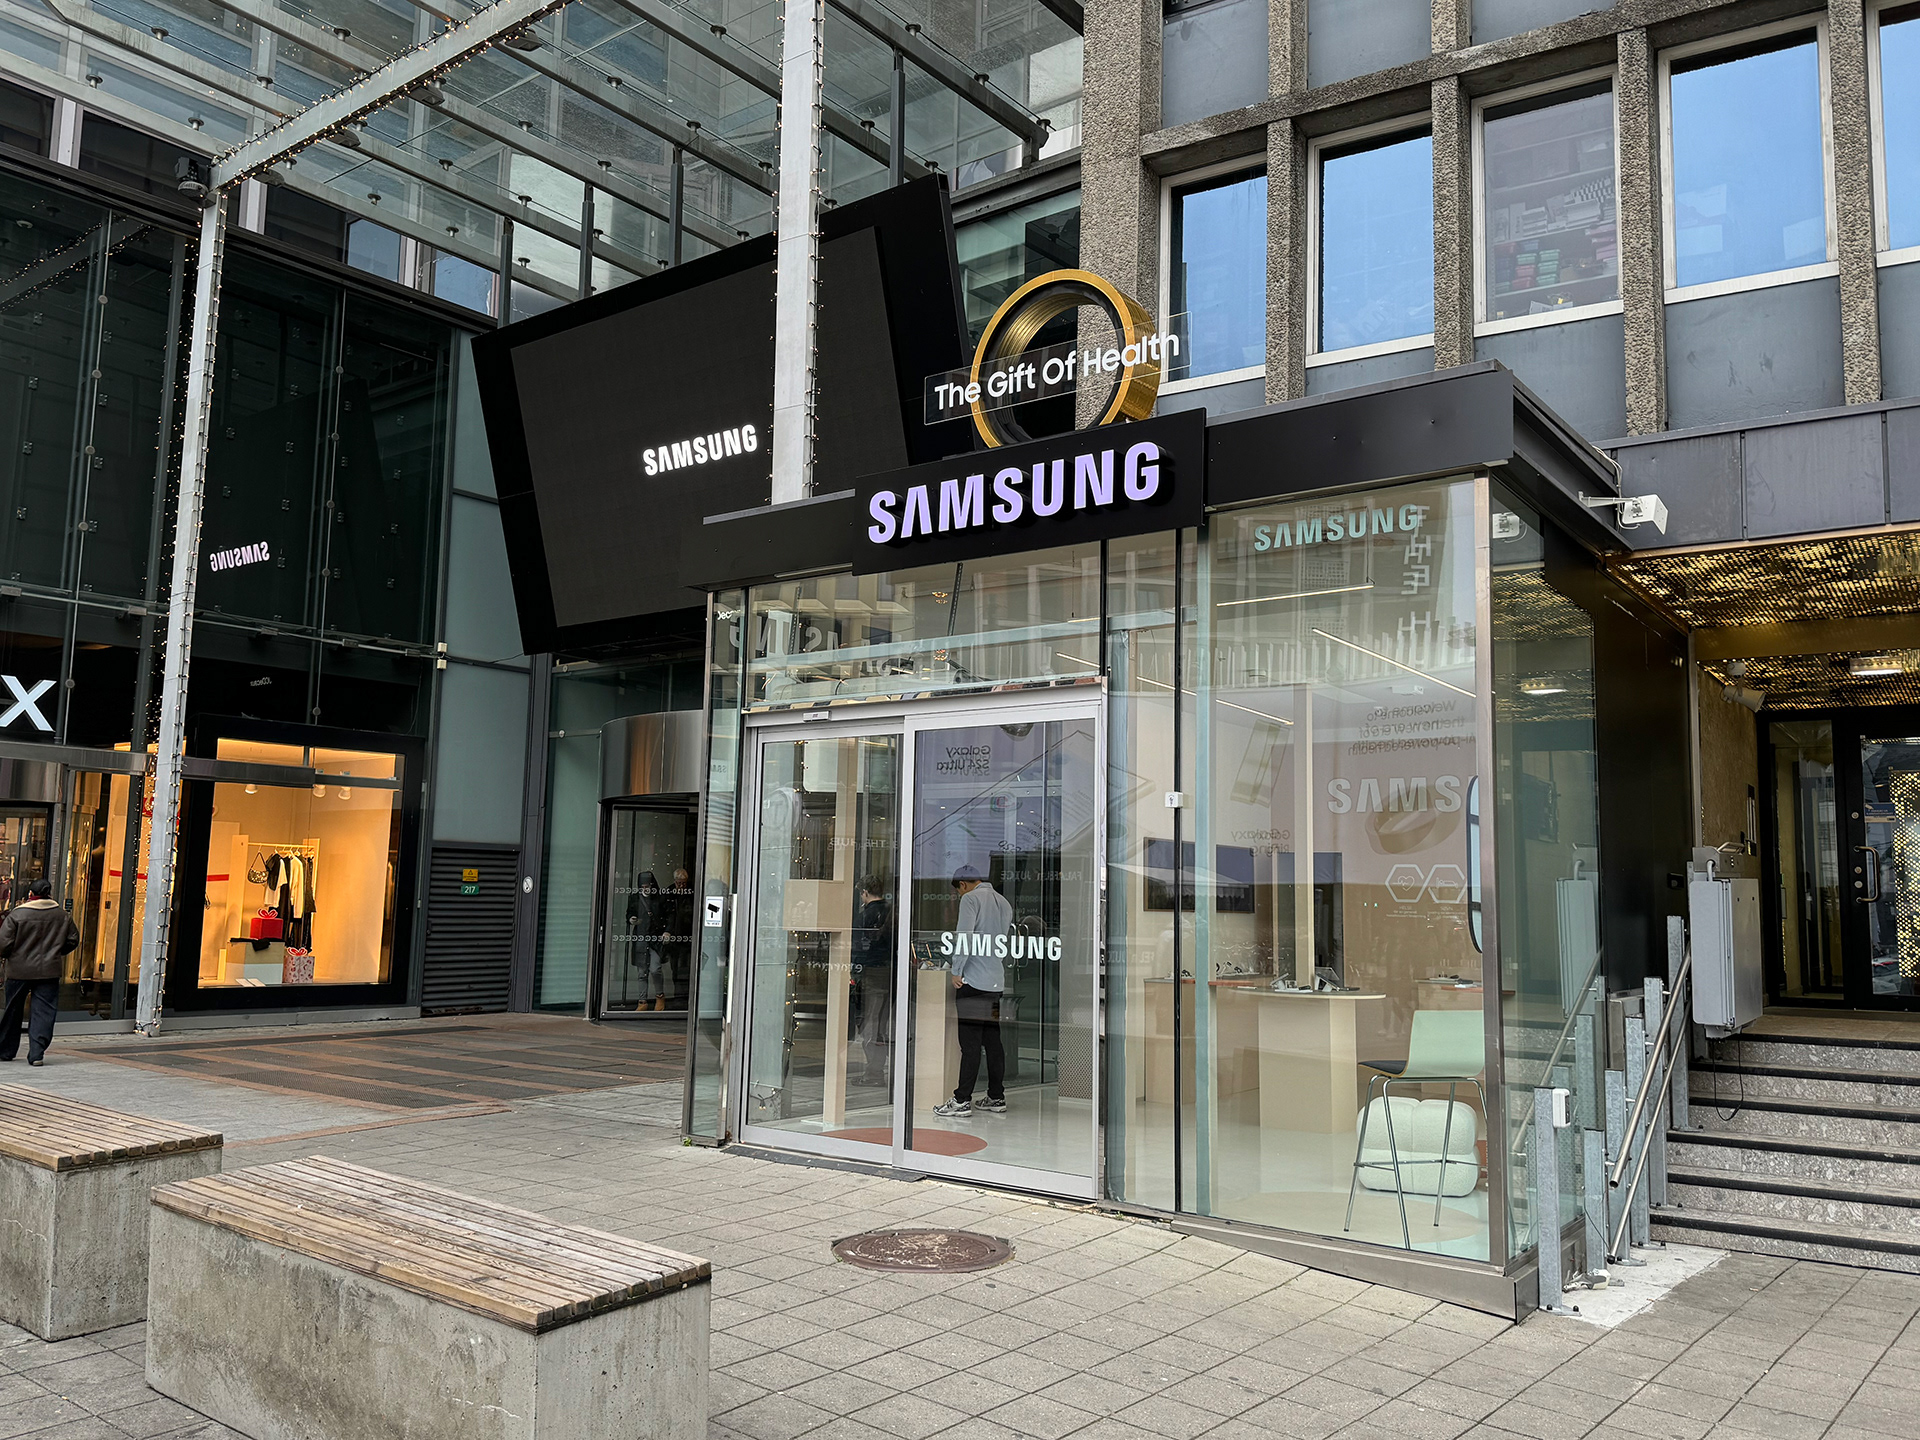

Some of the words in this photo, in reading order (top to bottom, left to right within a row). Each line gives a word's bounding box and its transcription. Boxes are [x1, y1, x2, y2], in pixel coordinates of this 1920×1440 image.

[934, 382, 982, 411] The
[987, 361, 1036, 398] Gift
[1042, 350, 1077, 386] Of
[1083, 332, 1181, 378] Health
[642, 424, 758, 476] SAMSUNG
[867, 441, 1160, 544] SAMSUNG
[1253, 503, 1418, 551] SAMSUNG
[1327, 775, 1475, 815] SAMS
[464, 885, 476, 894] 217
[940, 931, 1062, 961] SAMSUNG
